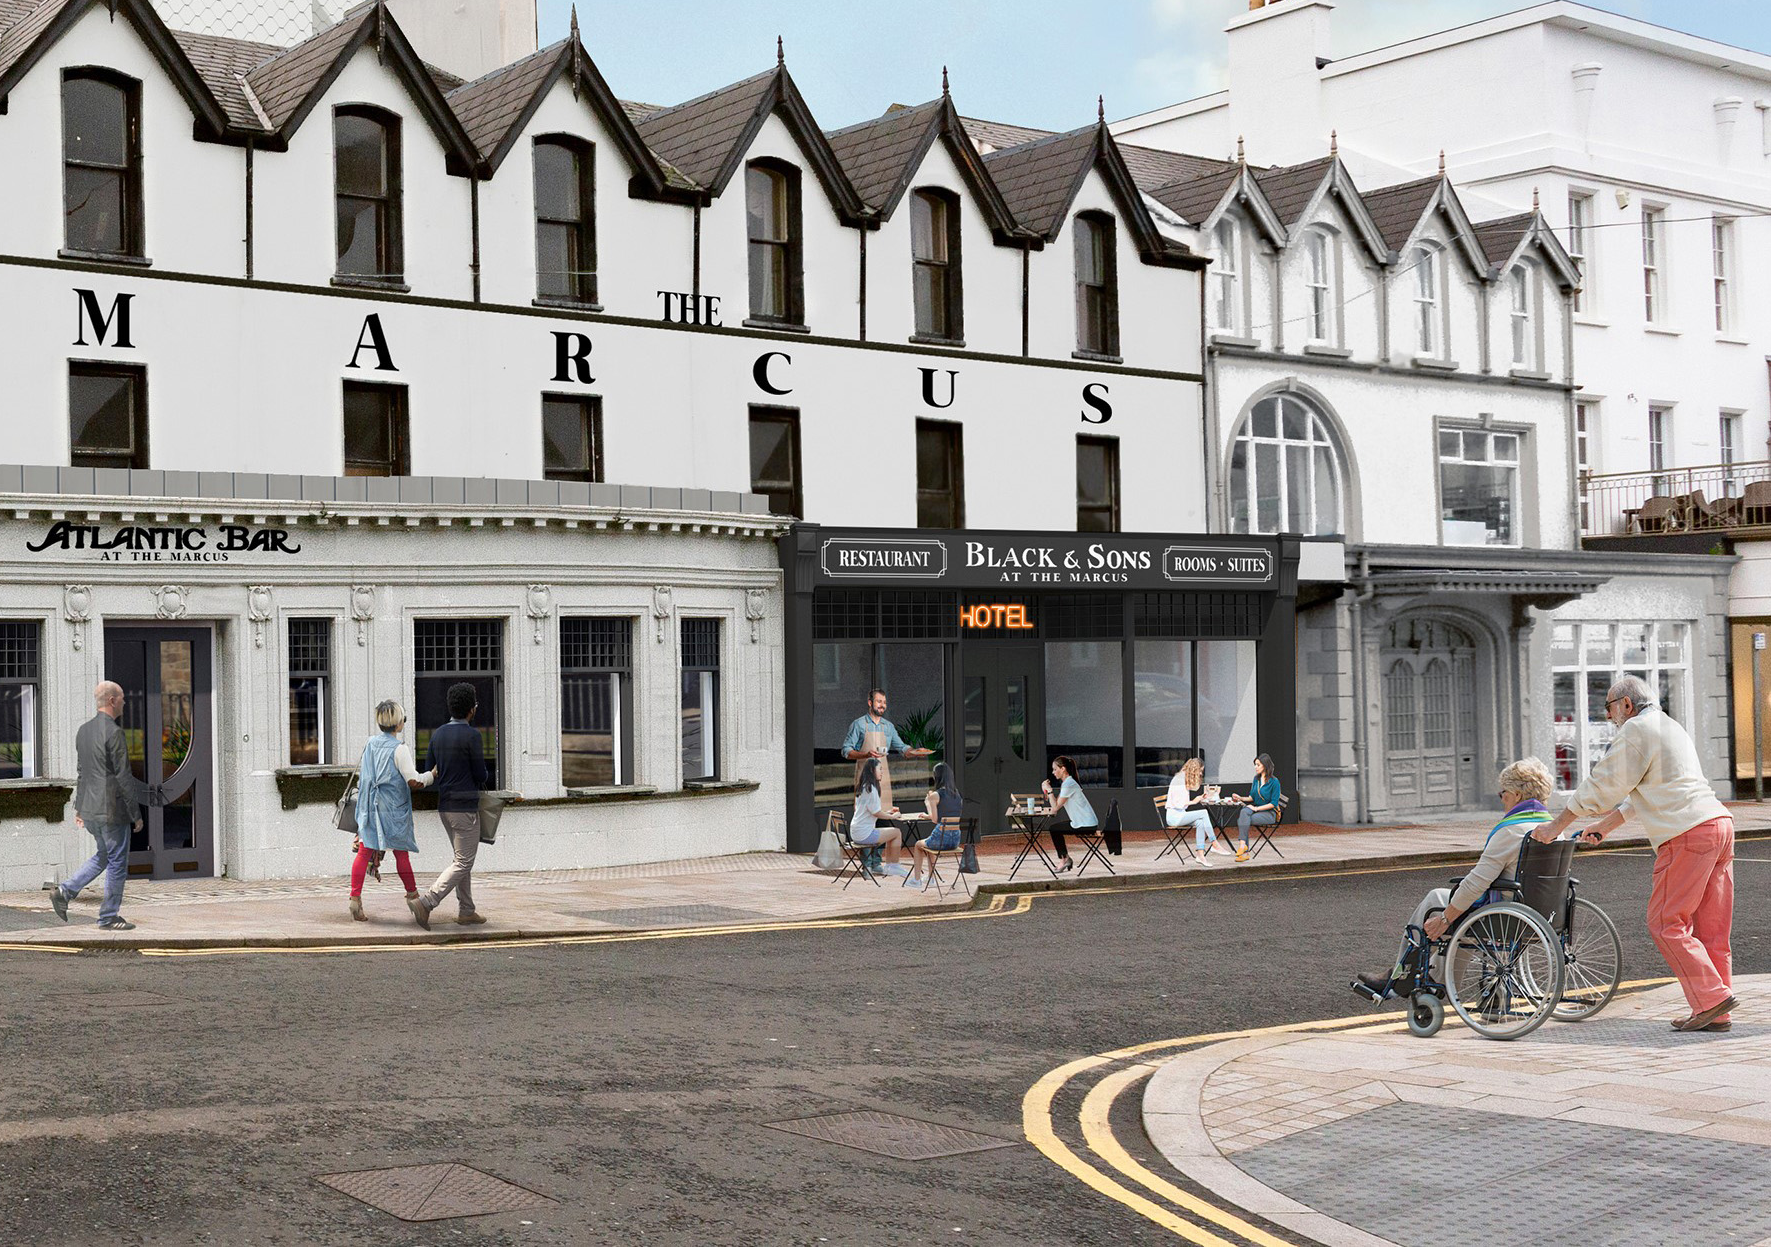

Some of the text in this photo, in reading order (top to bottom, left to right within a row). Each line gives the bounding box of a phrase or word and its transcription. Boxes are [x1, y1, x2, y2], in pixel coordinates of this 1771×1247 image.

[656, 290, 722, 327] THE
[100, 551, 229, 561] AT THE MARCUS
[839, 550, 930, 566] RESTAURANT
[1064, 549, 1080, 569] &
[1174, 556, 1216, 572] ROOMS
[1228, 558, 1266, 573] SUITES
[1000, 572, 1128, 583] AT THE MARCUS
[959, 604, 1034, 629] HOTEL
